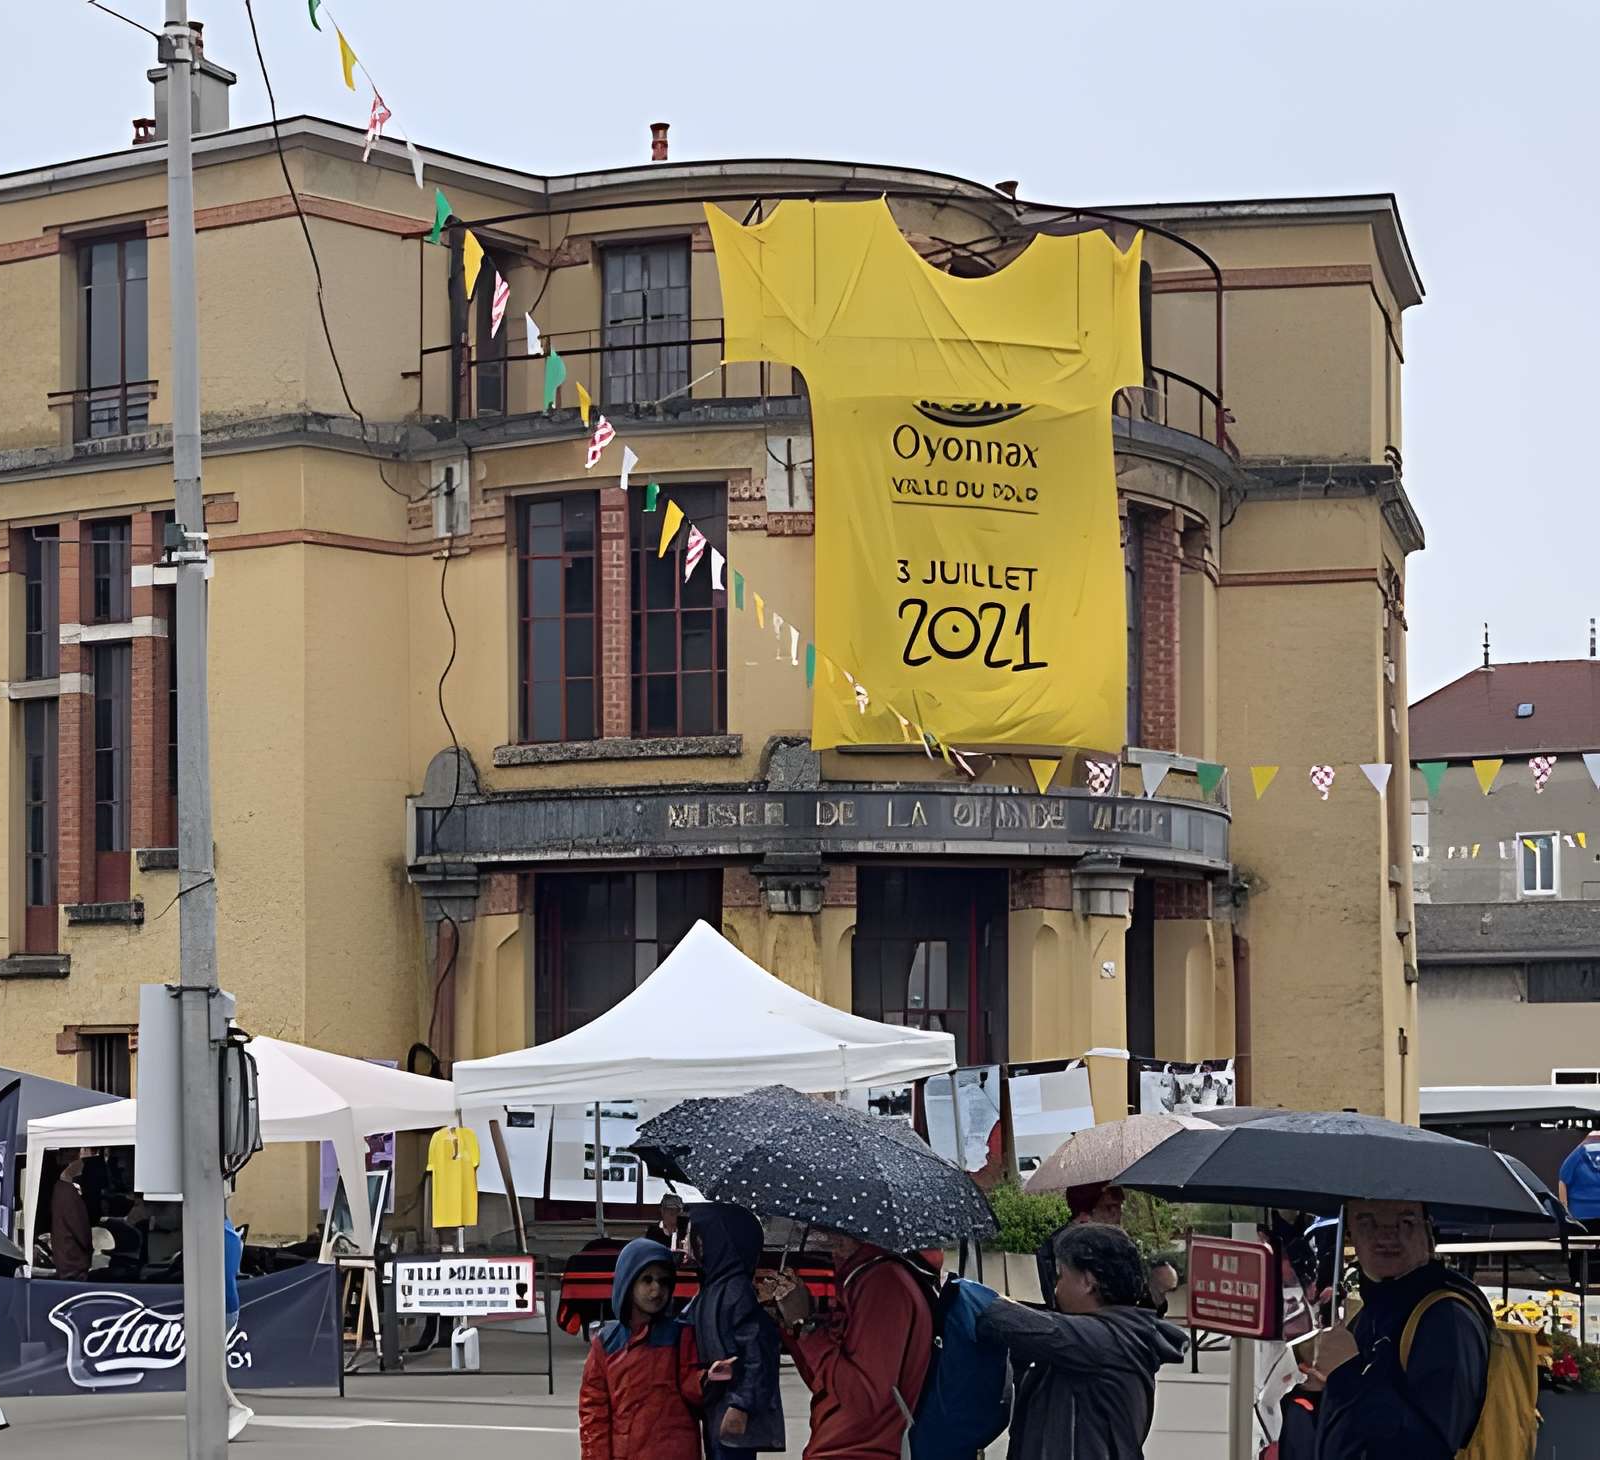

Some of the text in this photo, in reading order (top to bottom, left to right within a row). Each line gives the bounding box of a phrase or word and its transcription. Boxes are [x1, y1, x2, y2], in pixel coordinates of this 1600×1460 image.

[893, 423, 1039, 468] Oyonnax
[956, 480, 985, 499] DU
[896, 558, 1039, 592] 3 JUILLET
[897, 597, 1049, 673] 2021
[815, 799, 858, 827] DE
[887, 799, 930, 828] LA
